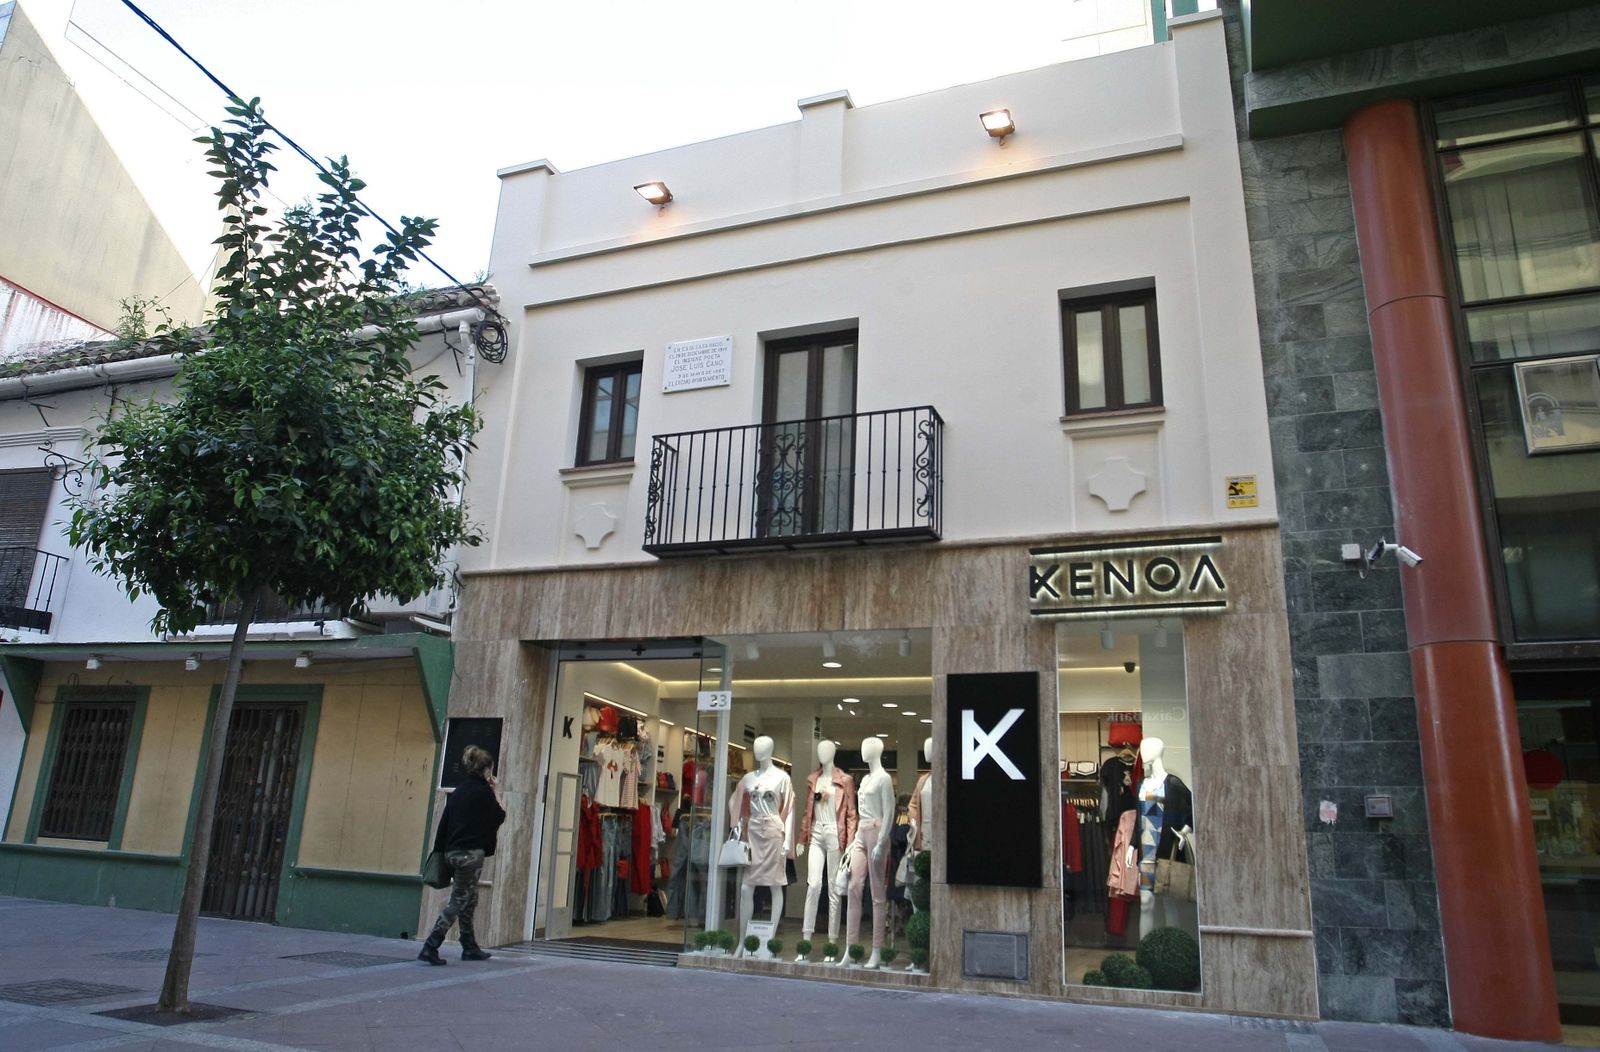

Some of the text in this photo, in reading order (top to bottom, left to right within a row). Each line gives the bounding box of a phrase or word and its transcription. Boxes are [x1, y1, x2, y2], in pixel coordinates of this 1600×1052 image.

[689, 362, 704, 370] LUIS
[706, 360, 724, 368] CANO
[1028, 554, 1226, 600] KENOA
[562, 715, 575, 739] K
[961, 708, 1027, 780] K
